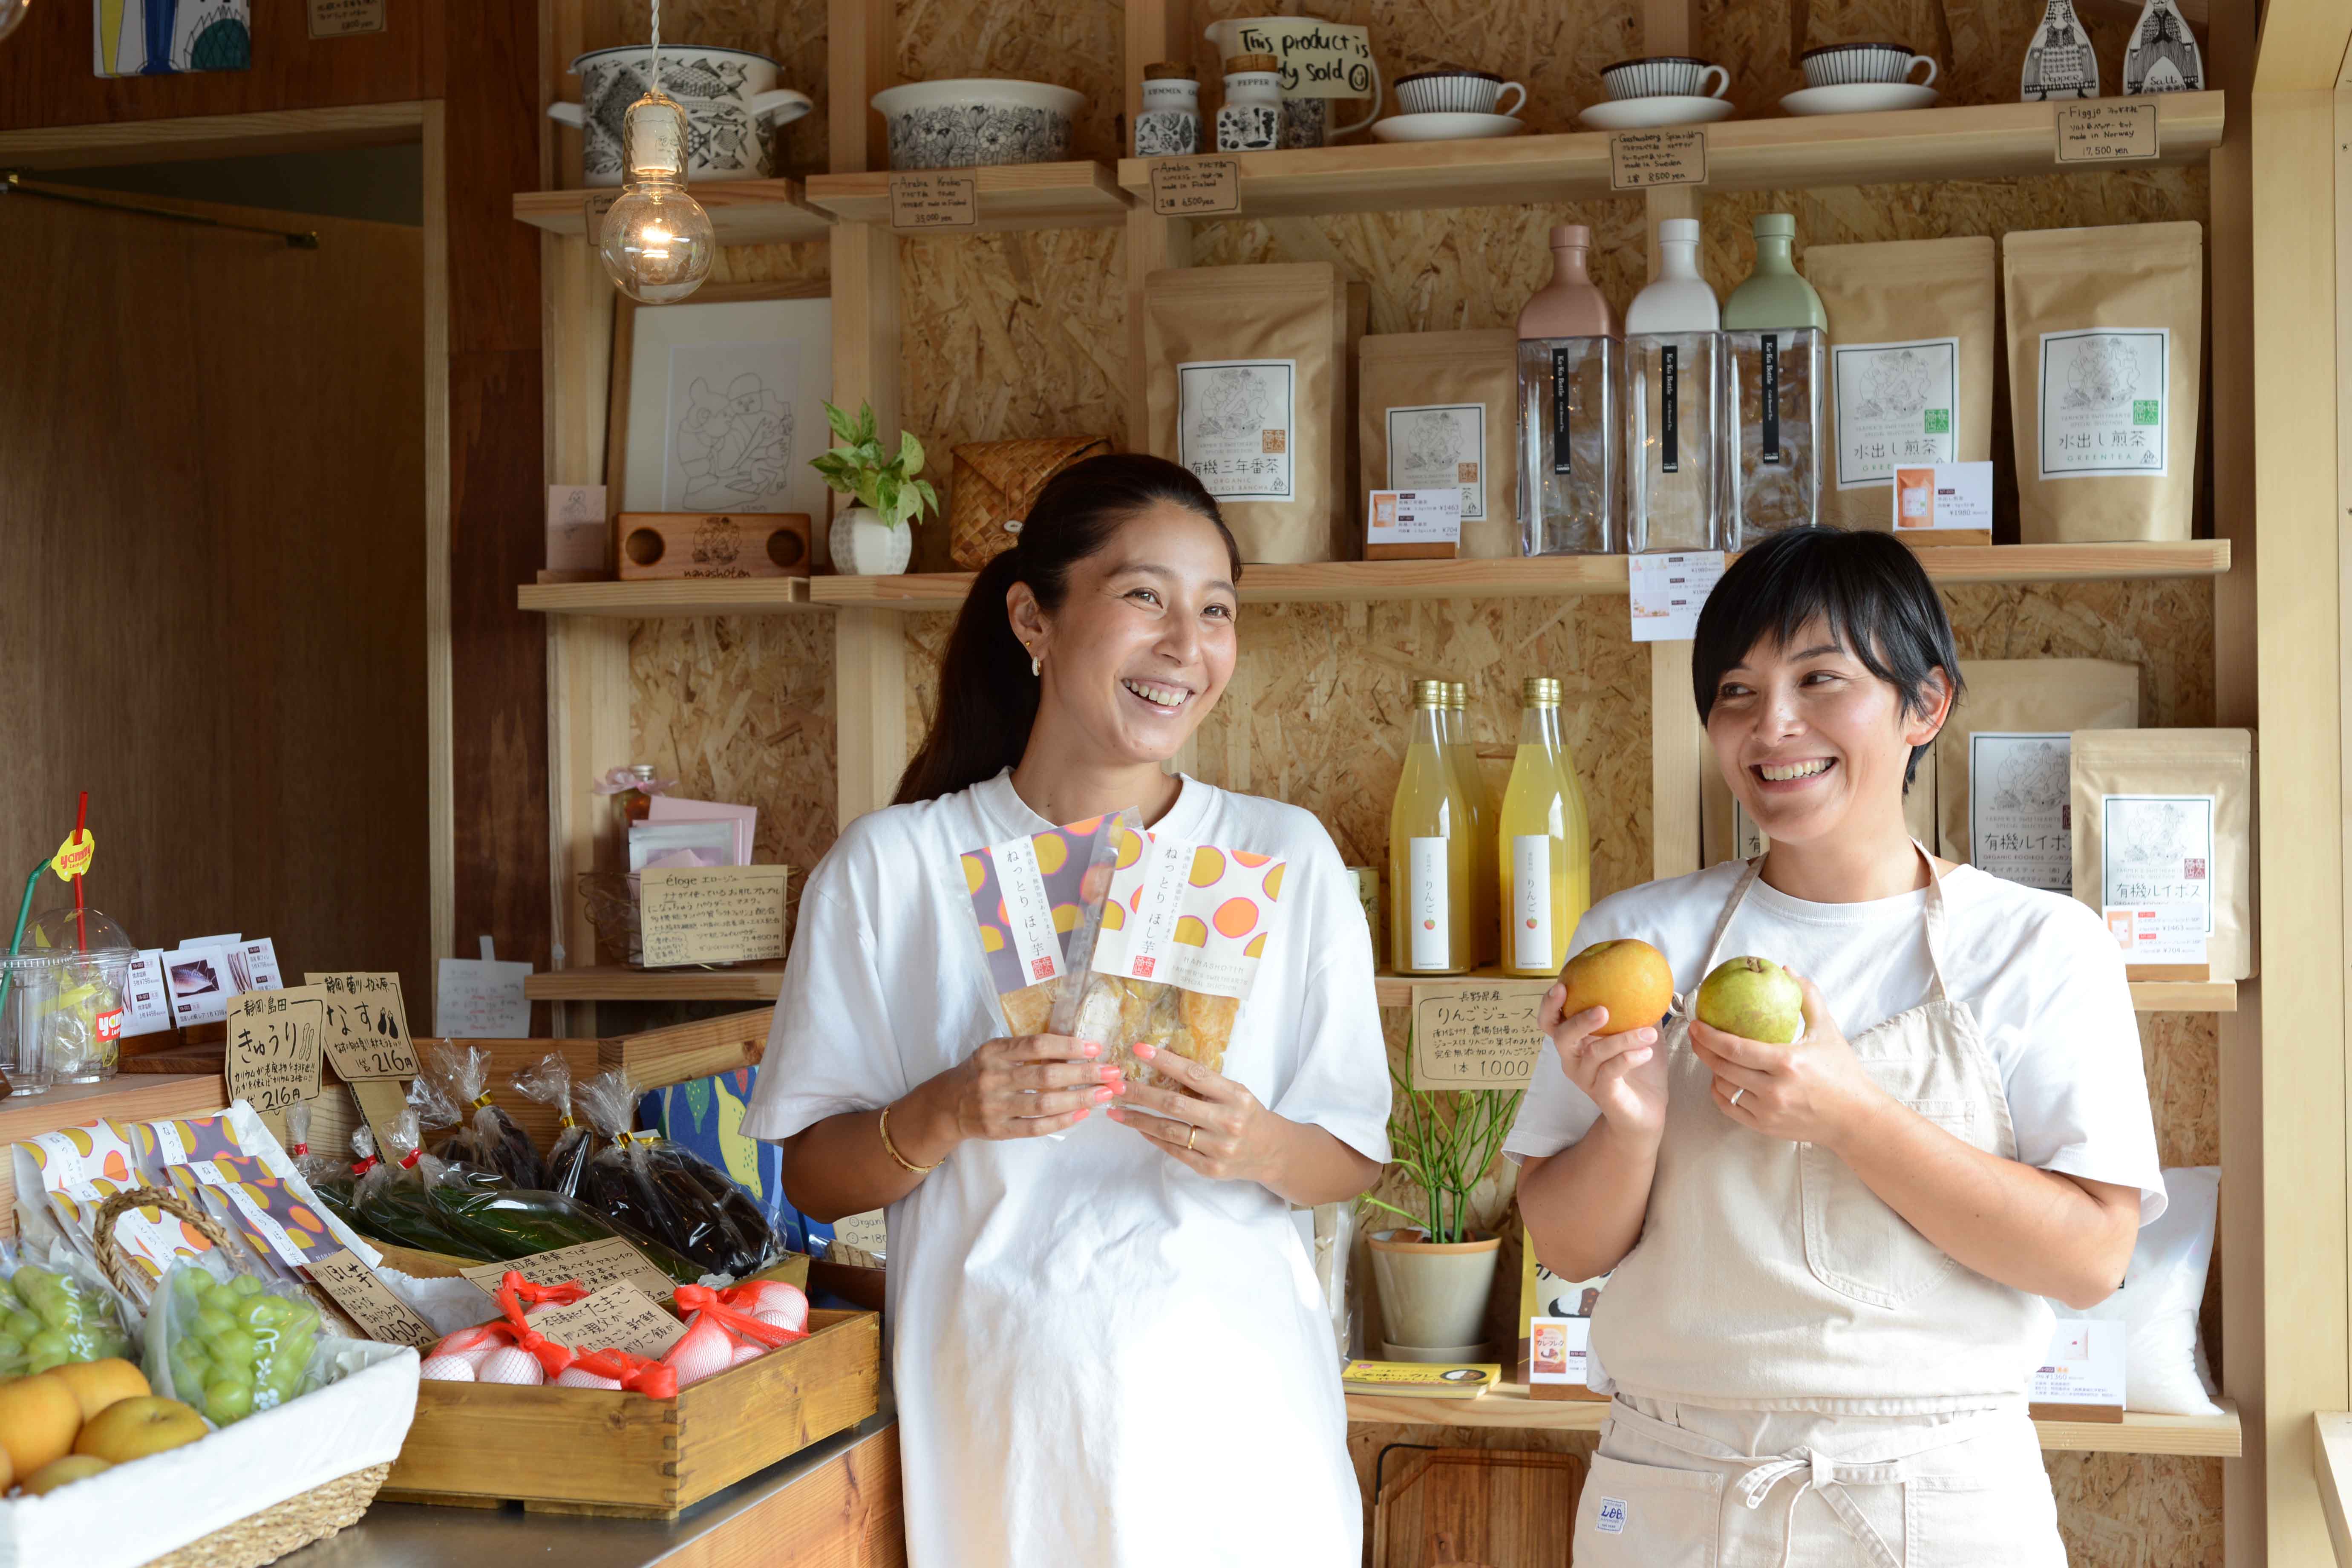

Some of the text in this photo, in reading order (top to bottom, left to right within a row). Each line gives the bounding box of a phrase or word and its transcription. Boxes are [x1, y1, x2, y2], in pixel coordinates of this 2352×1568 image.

[1240, 28, 1369, 58] This product is
[1306, 59, 1344, 81] sold
[1237, 78, 1270, 87] PEPPER
[2069, 106, 2101, 119] Figgjo
[2083, 146, 2111, 156] 17,500
[1160, 162, 1190, 172] Arabia
[1854, 439, 1937, 459] 水出し煎茶
[2059, 430, 2146, 449] 水出し煎茶
[1191, 458, 1279, 475] 有機三年番茶
[684, 568, 750, 578] nanashoten
[1985, 833, 2072, 851] 有機ルイボ
[61, 843, 91, 869] yammy
[666, 874, 697, 888] éloge
[1154, 845, 1179, 903] ねっとり
[1424, 879, 1435, 914] りんご
[1526, 878, 1537, 912] りんご
[2116, 883, 2200, 898] 有機ルイボス
[1006, 850, 1029, 909] ねっとり
[1023, 914, 1044, 957] ほし芋
[1141, 912, 1161, 954] ほし芋
[325, 976, 344, 994] 静岡
[244, 996, 286, 1017] 静岡・島田
[1459, 990, 1503, 1003] 長野県産
[98, 1012, 123, 1036] yam
[326, 1001, 372, 1036] なす
[1438, 1005, 1537, 1025] りんごジュース
[238, 1022, 296, 1063] きゅうり
[372, 1050, 412, 1072] 216円
[1454, 1061, 1469, 1074] 1本
[262, 1087, 300, 1109] 216円
[163, 1126, 178, 1164] ねっと
[849, 1217, 885, 1228] Organi
[584, 1286, 630, 1317] たまご
[379, 1319, 422, 1342] 950円
[1601, 1505, 1622, 1519] Lee
